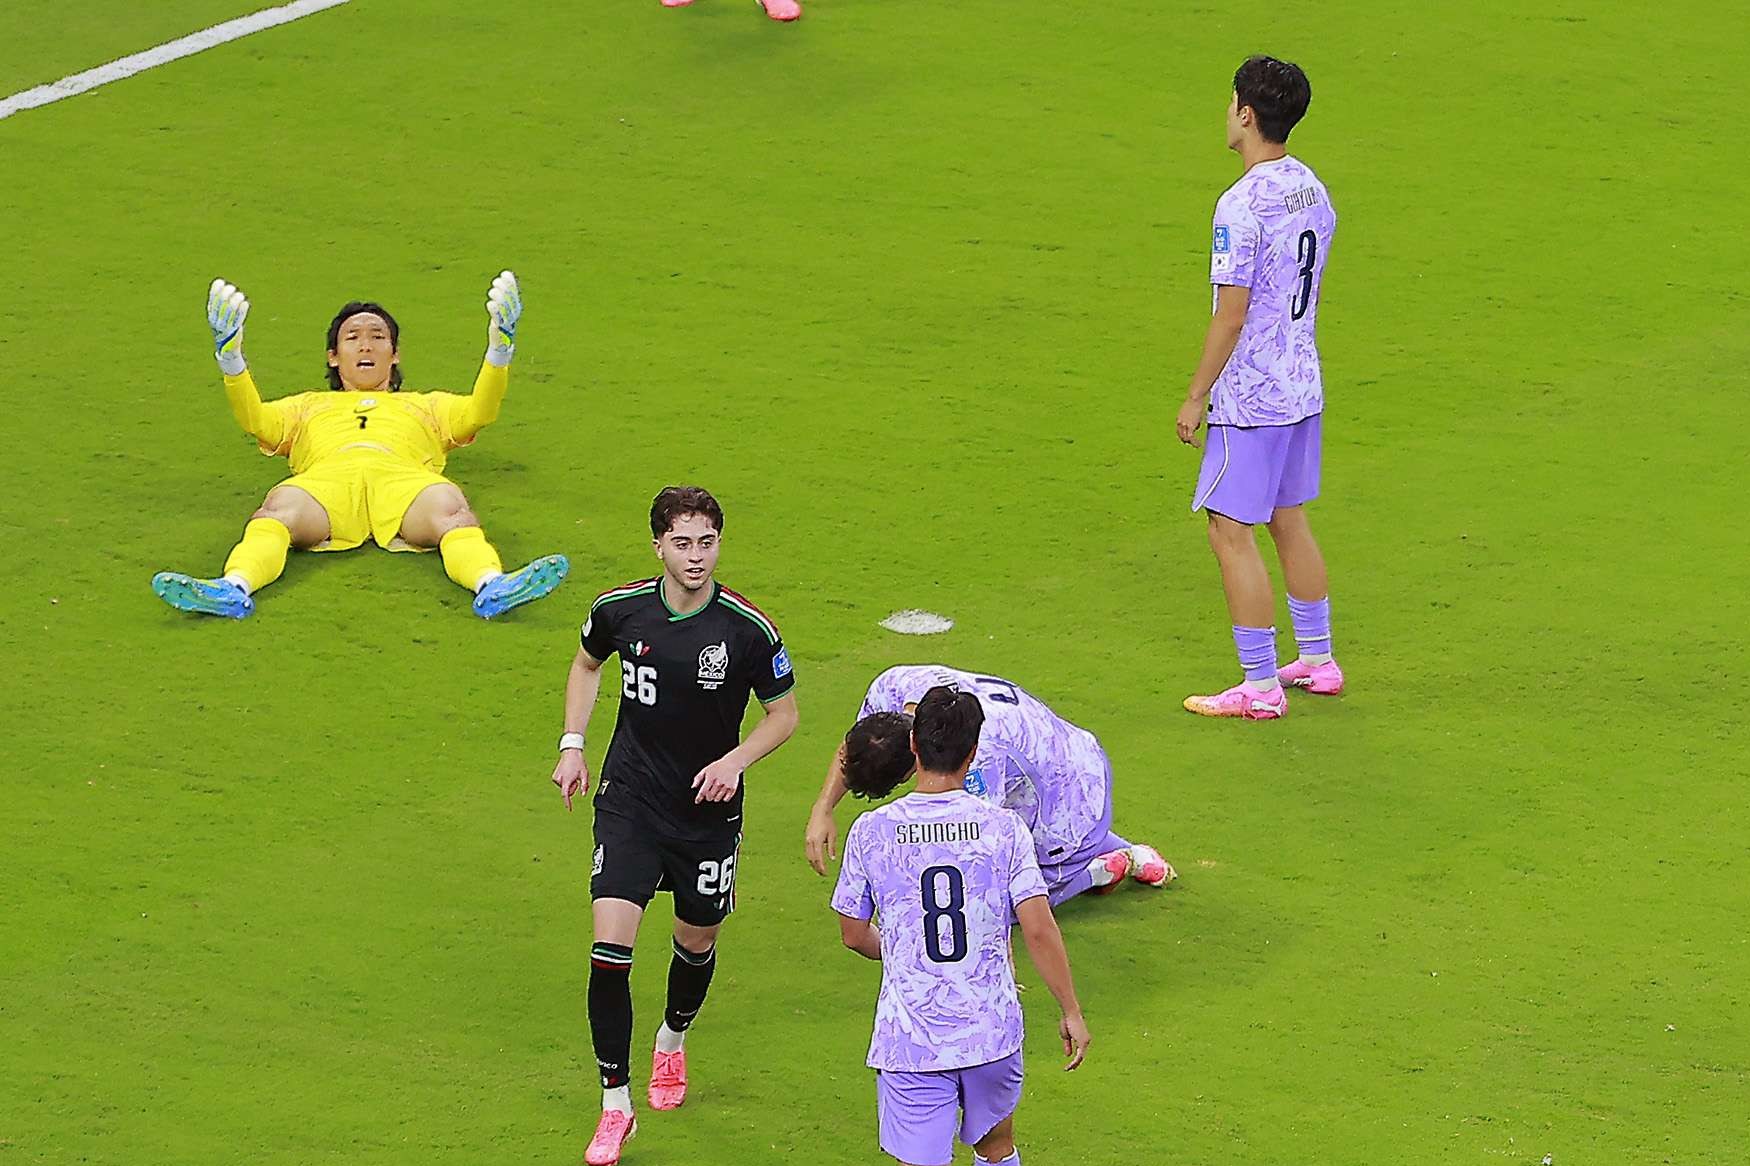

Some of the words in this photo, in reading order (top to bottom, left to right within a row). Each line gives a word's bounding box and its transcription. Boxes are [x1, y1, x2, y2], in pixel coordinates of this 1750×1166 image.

[1291, 229, 1317, 321] 3
[622, 660, 657, 706] 26
[897, 822, 981, 844] SEUNGHO
[697, 860, 734, 895] 26
[920, 865, 968, 963] 8
